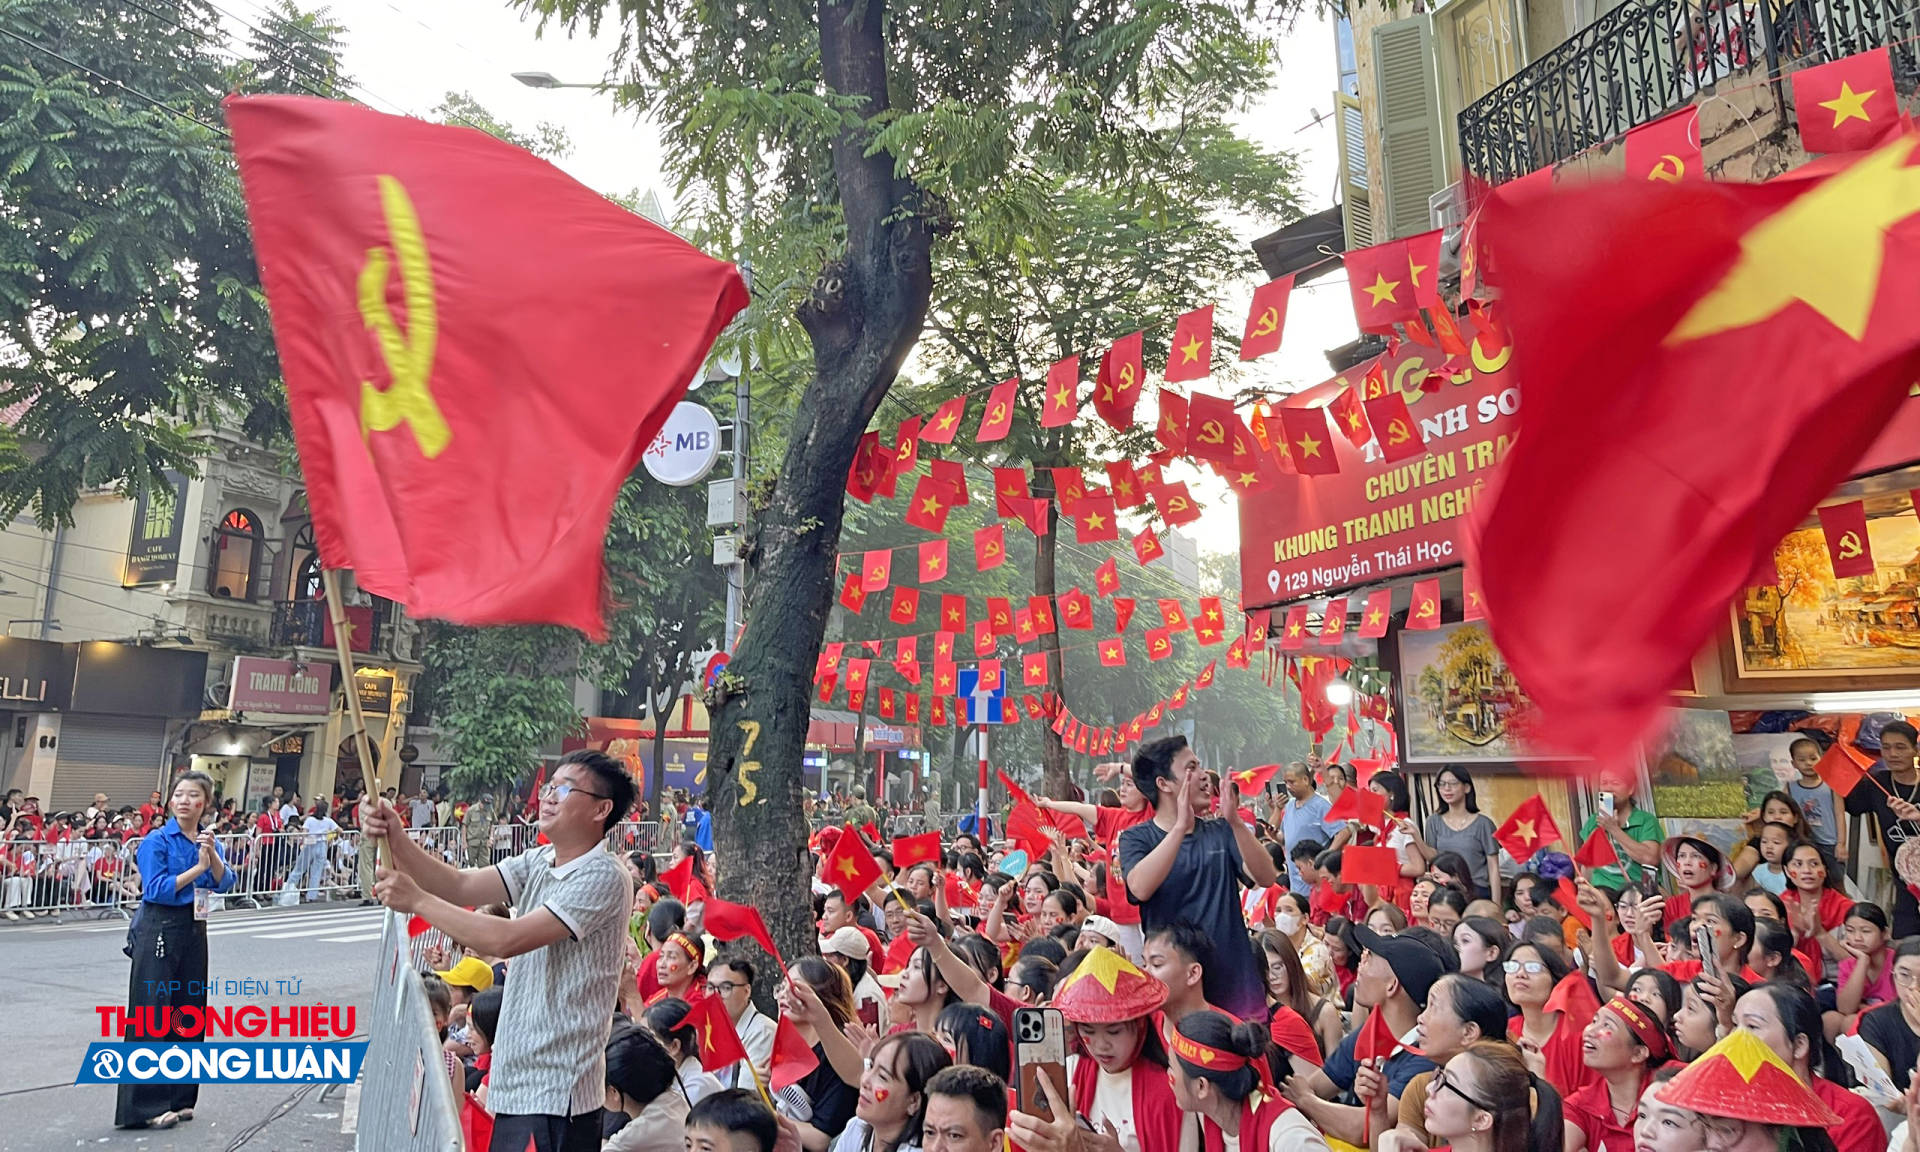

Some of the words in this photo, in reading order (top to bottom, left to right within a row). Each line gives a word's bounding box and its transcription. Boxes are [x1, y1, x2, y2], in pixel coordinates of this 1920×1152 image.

[675, 431, 711, 452] MB
[1360, 404, 1468, 463] TNH
[1365, 450, 1457, 502] CHUYÊN
[1462, 431, 1518, 473] TRA
[1274, 525, 1338, 563] KHUNG
[1343, 503, 1415, 545] TRANH
[1284, 571, 1309, 592] 129
[1312, 554, 1371, 586] Nguyễn
[1374, 547, 1412, 572] Thái
[1416, 540, 1453, 563] Học
[0, 676, 47, 701] LLI
[249, 672, 287, 693] TRANH
